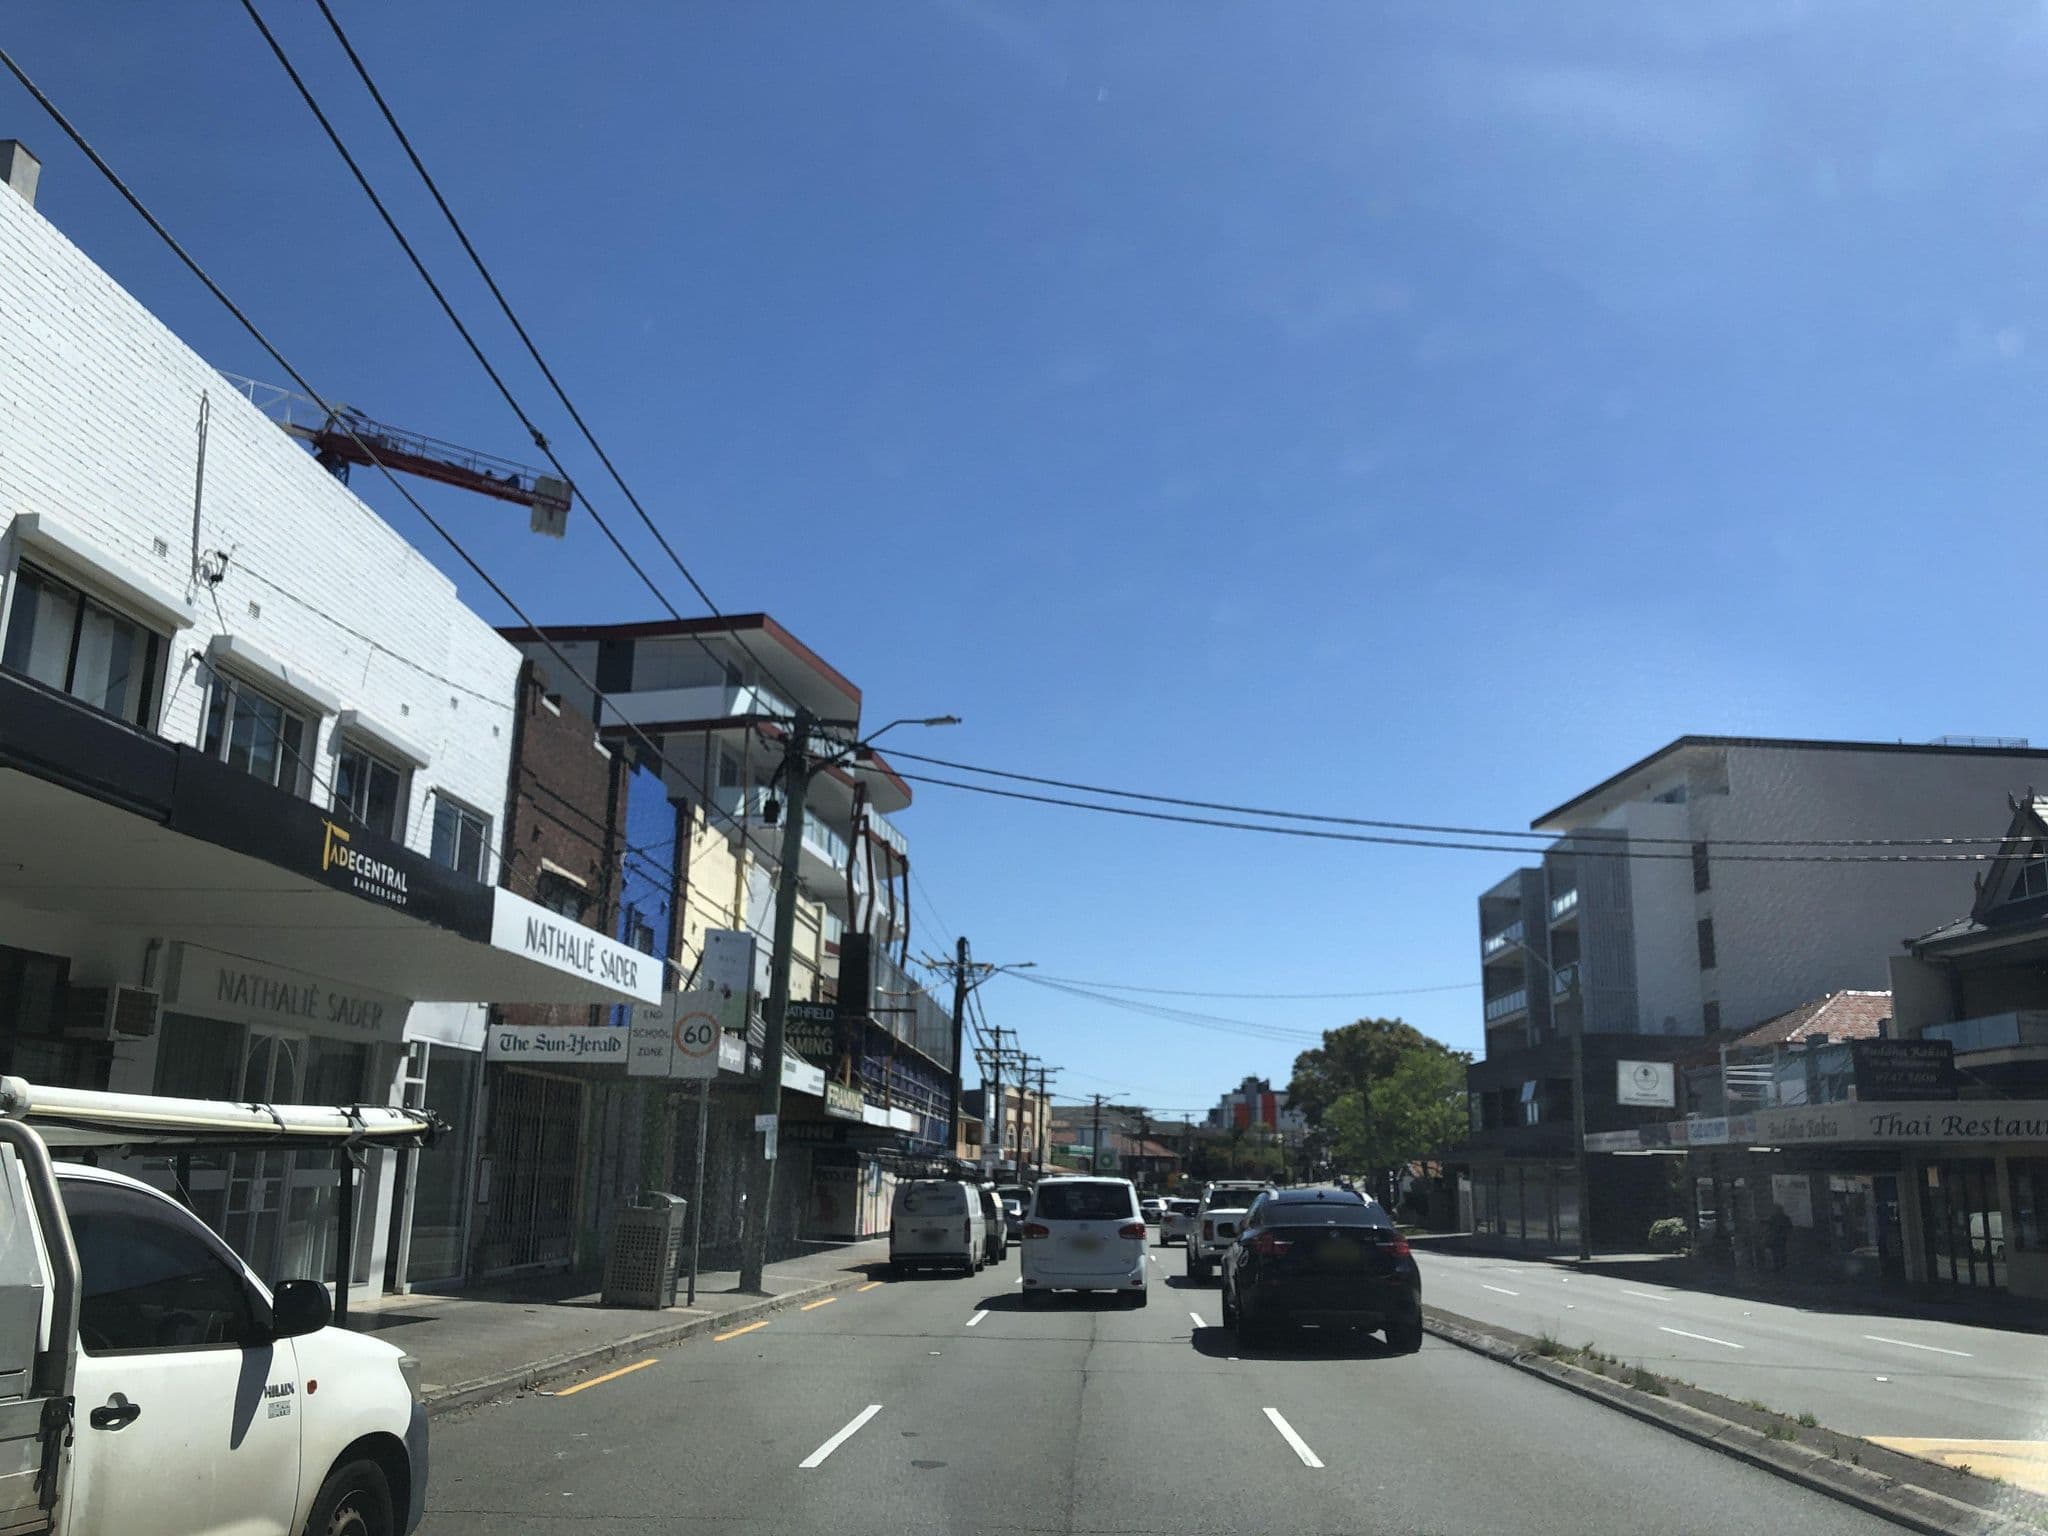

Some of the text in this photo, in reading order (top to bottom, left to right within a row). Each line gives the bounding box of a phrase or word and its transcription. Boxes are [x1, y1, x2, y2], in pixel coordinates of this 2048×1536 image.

[353, 877, 407, 905] BARBERSHOP
[600, 949, 638, 989] SADER
[327, 991, 383, 1031] SADER
[643, 1010, 664, 1020] END
[785, 1005, 834, 1020] ATHFIELD
[633, 1028, 670, 1039] SCHOOL
[684, 1025, 712, 1044] 60
[500, 1033, 621, 1055] The Sun-Herald
[638, 1047, 664, 1056] ZONE
[1870, 1113, 1932, 1137] Thai
[264, 1381, 295, 1398] HILUX
